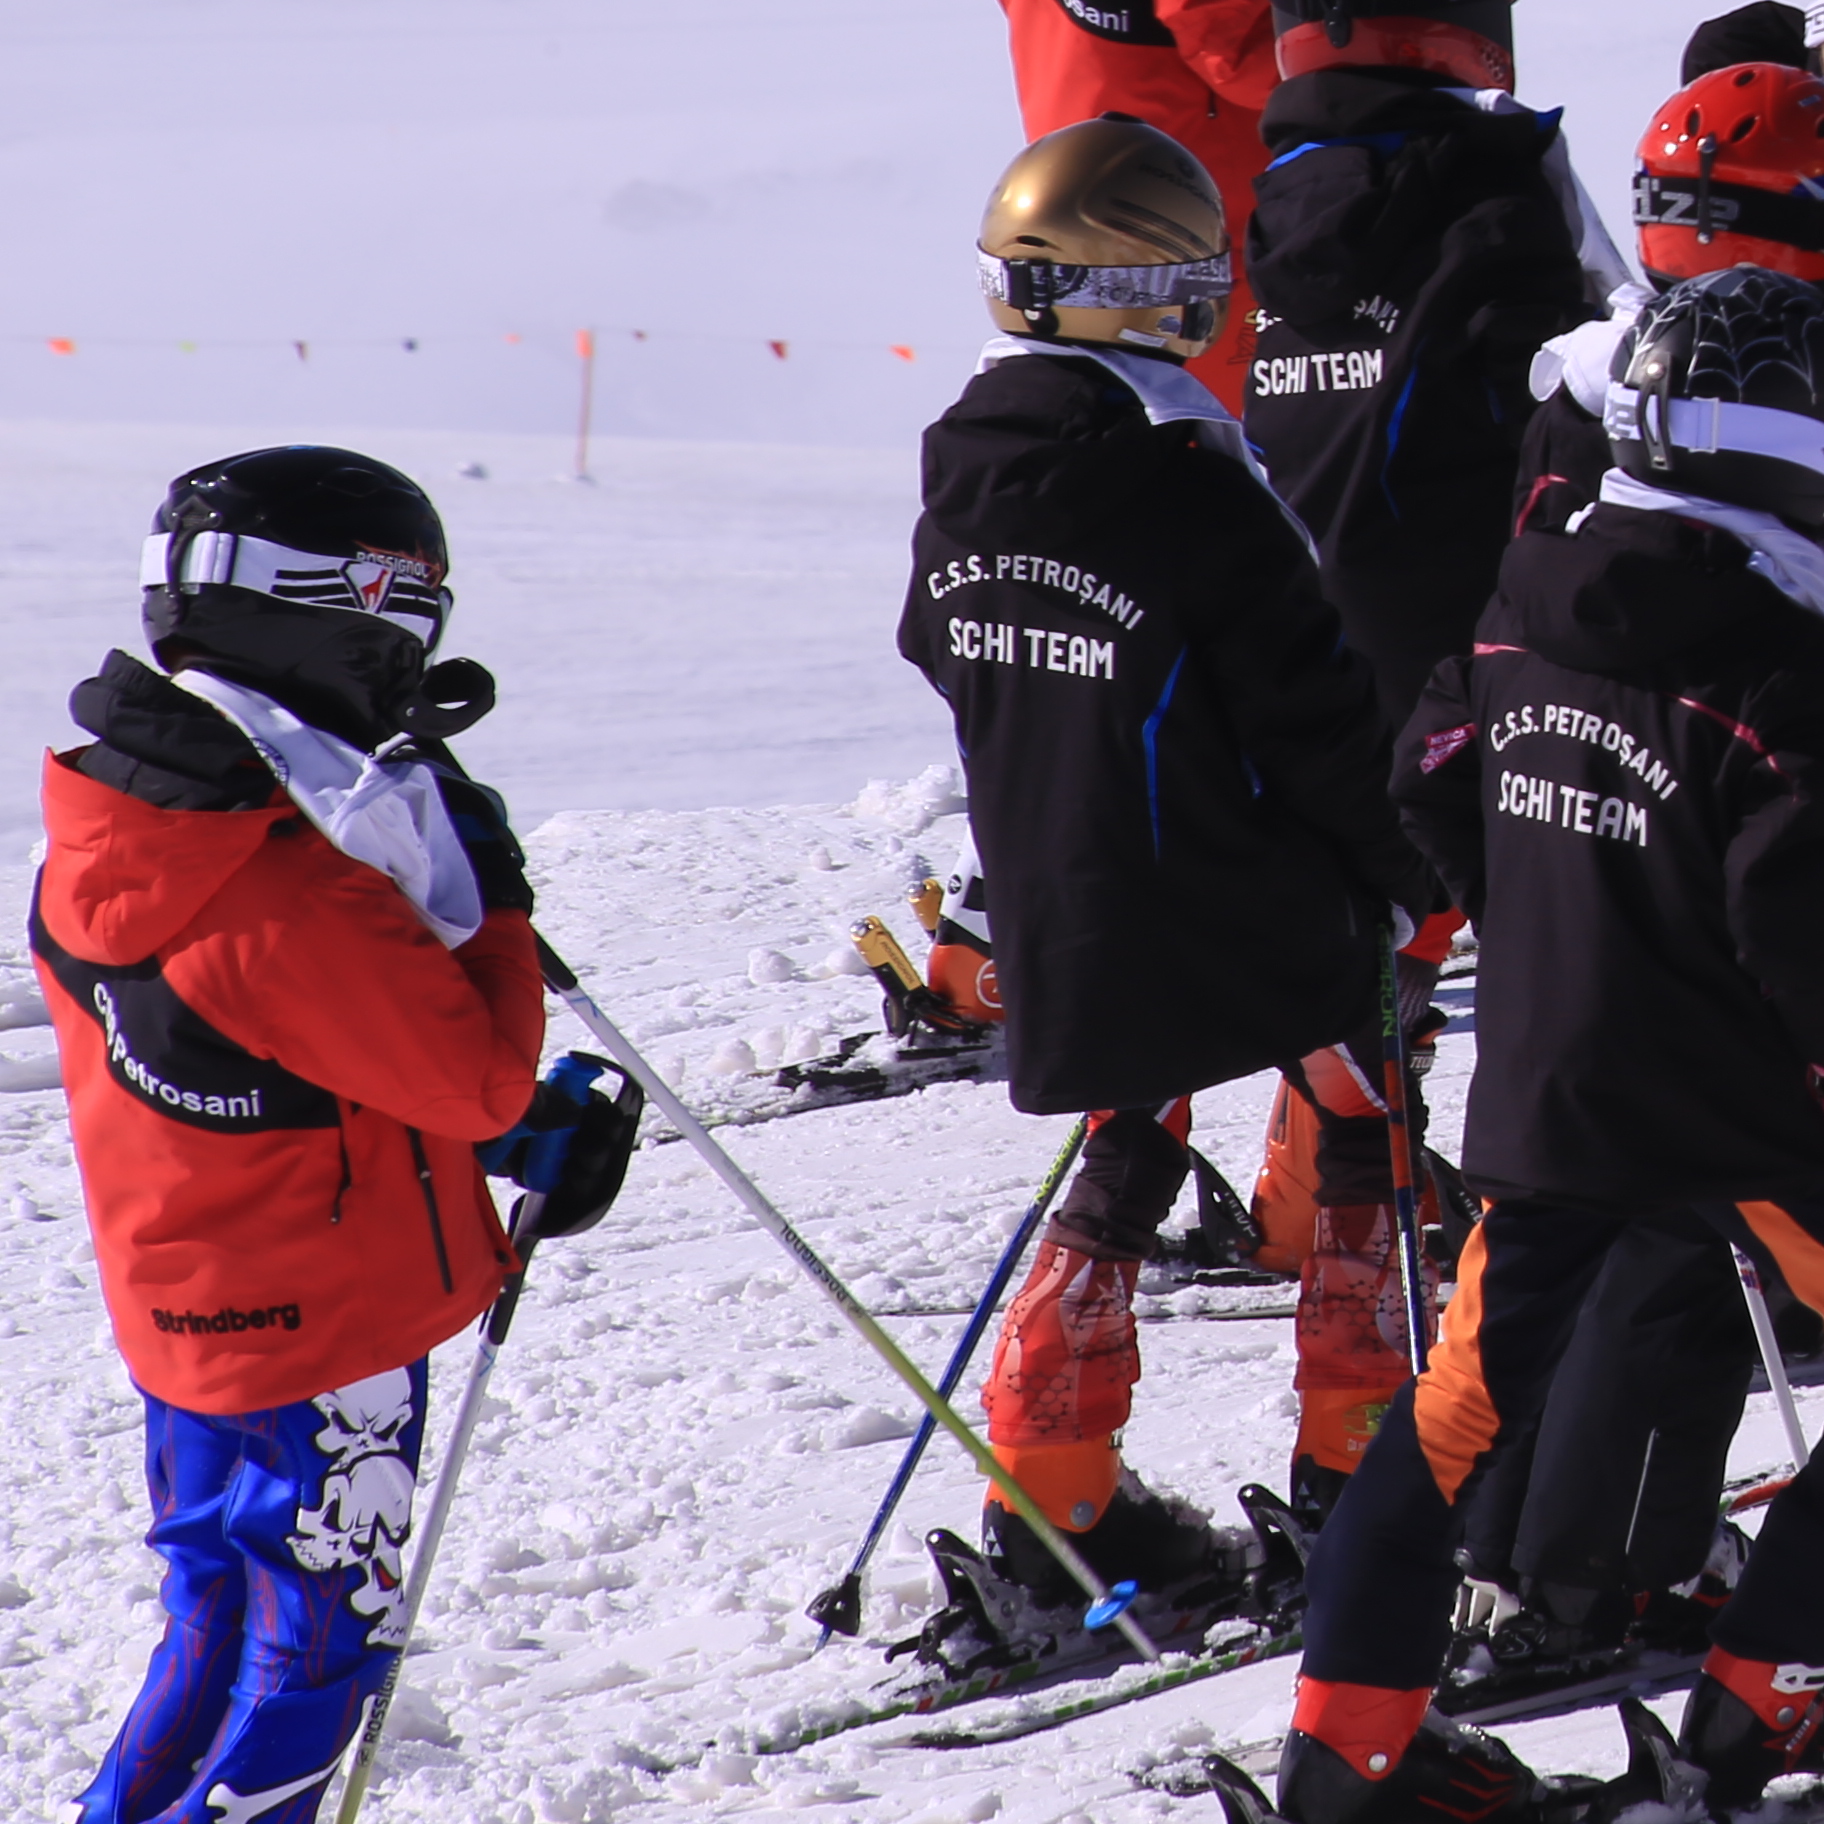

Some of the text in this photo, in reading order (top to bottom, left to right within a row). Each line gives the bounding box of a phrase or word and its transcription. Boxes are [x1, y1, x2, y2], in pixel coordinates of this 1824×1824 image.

[1254, 348, 1383, 398] SCHI TEAM
[927, 554, 991, 601] C.S.S.
[949, 616, 1115, 680] SCHI TEAM
[1490, 704, 1540, 752] C.S.S.
[1497, 769, 1648, 848] SCHI TEAM
[112, 1031, 264, 1118] Petrosani
[151, 1302, 302, 1335] Strindberg
